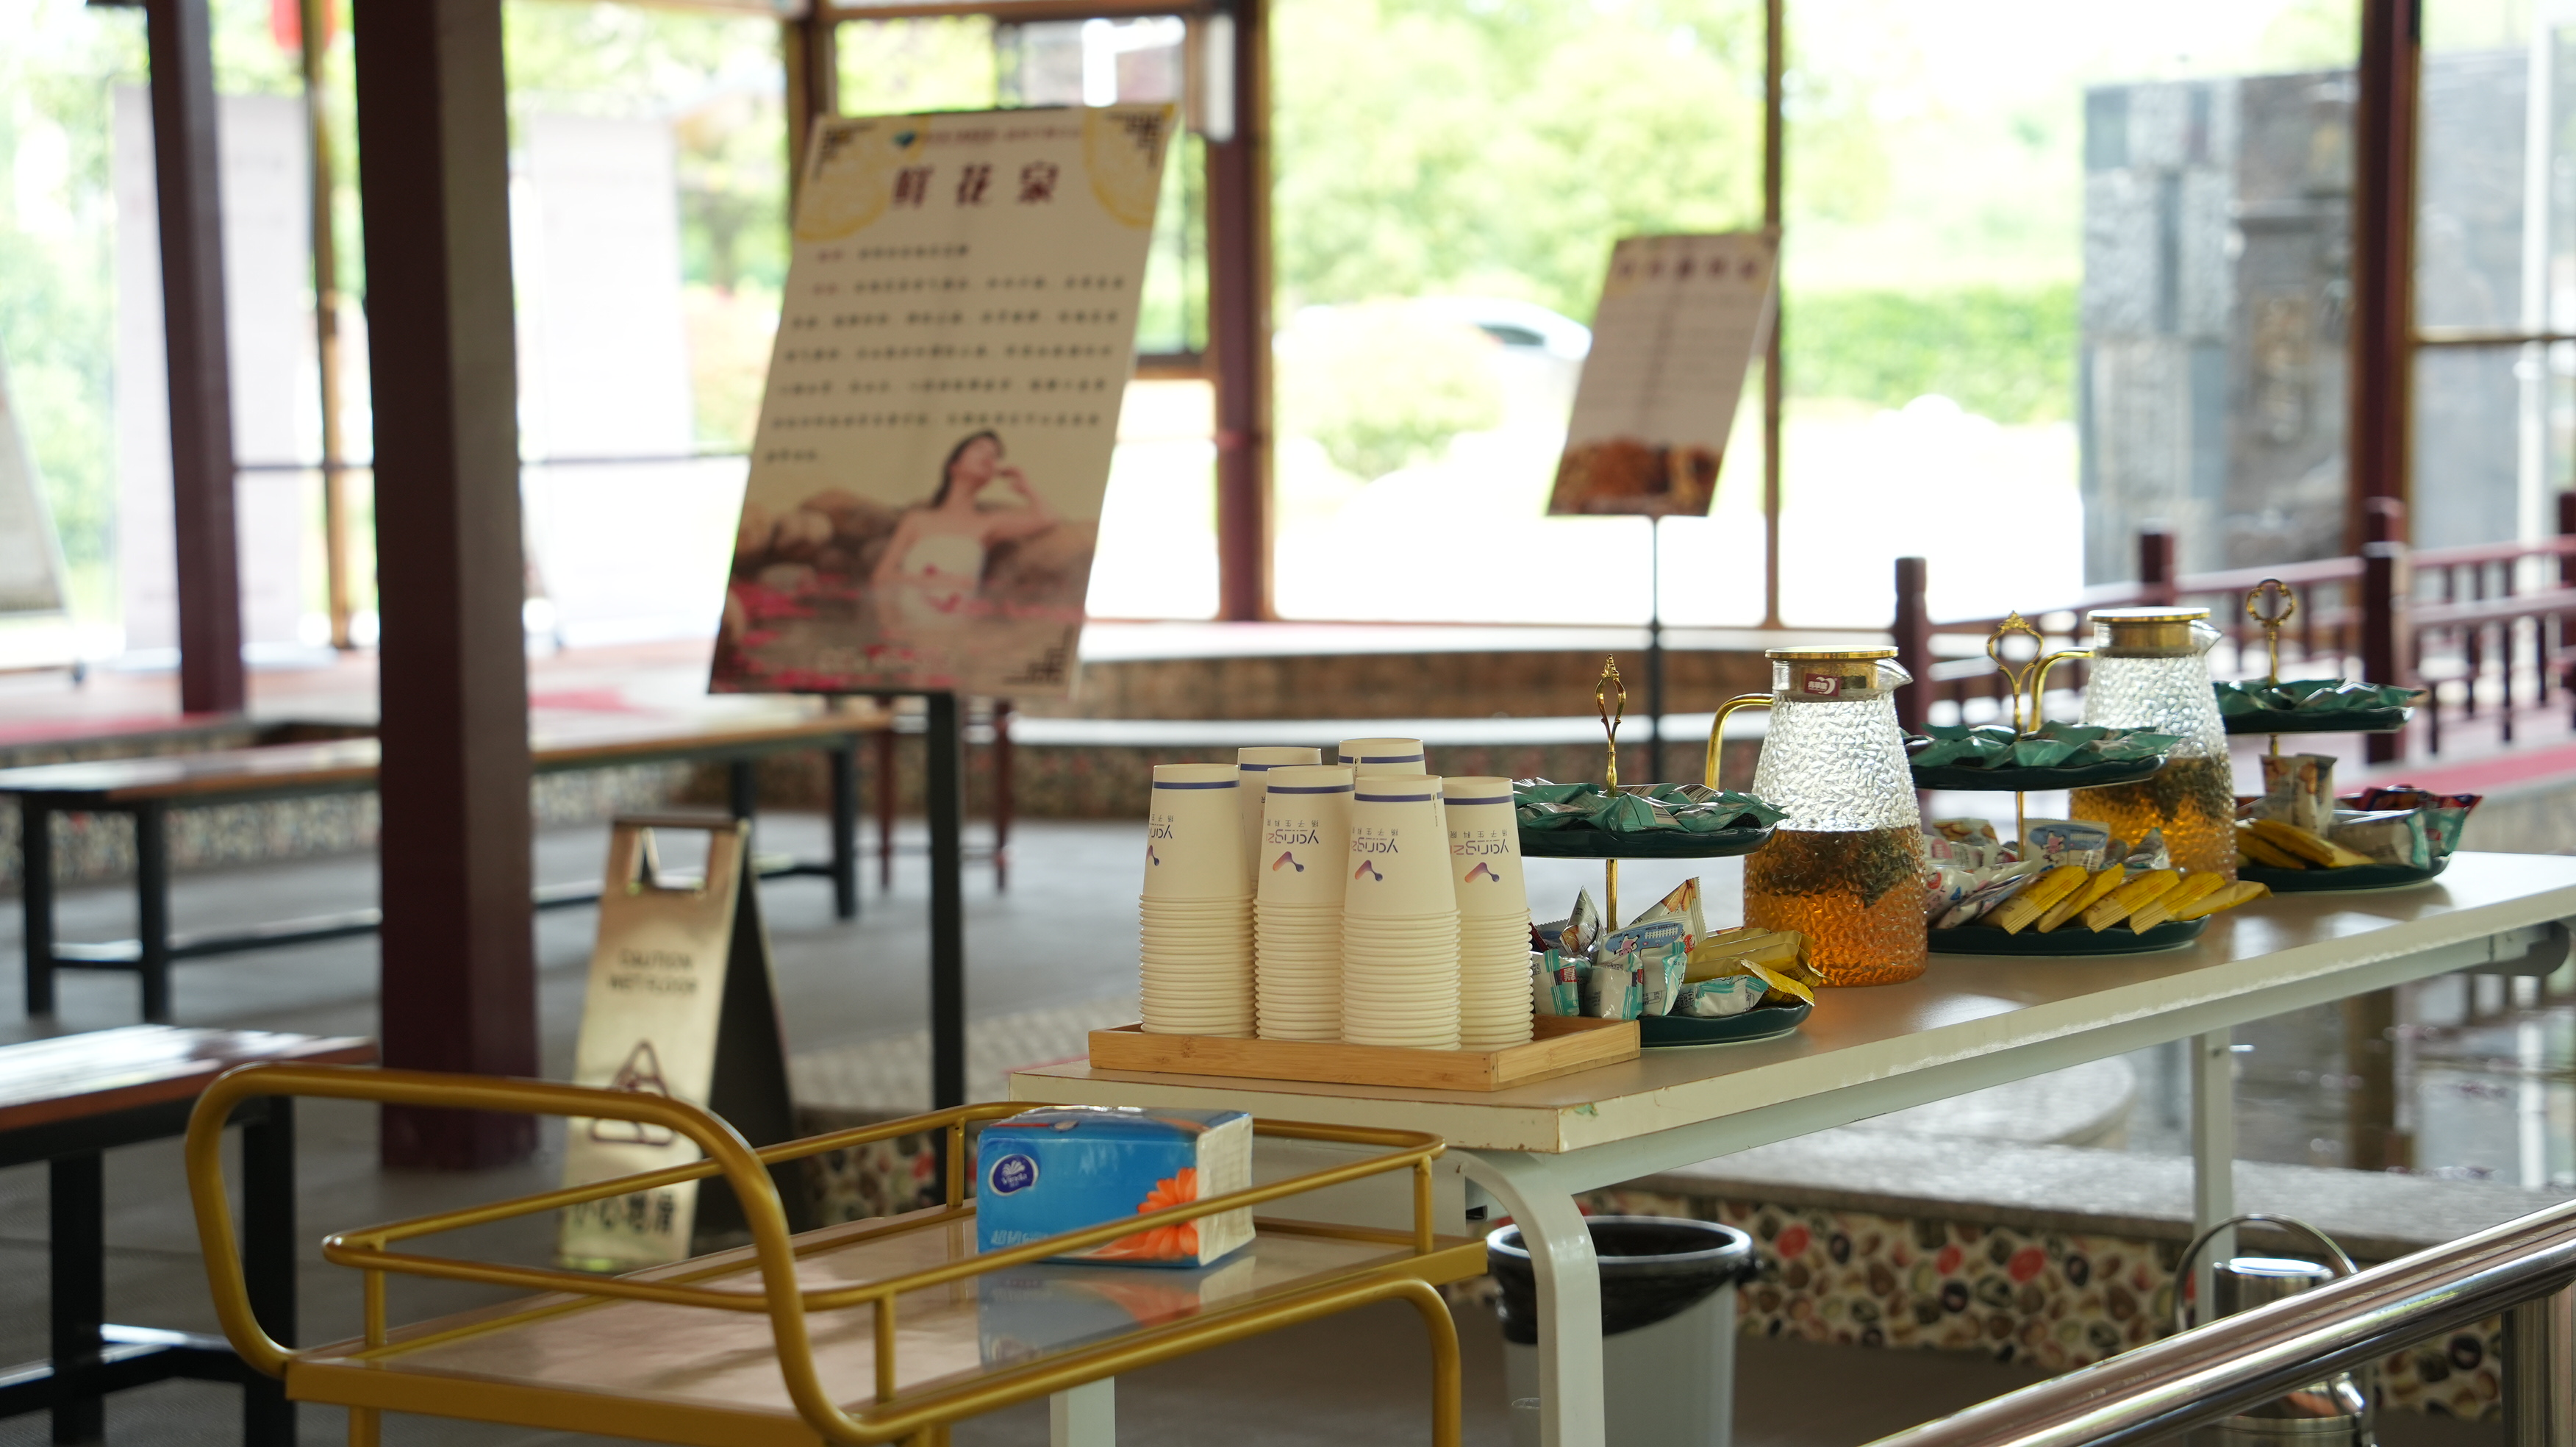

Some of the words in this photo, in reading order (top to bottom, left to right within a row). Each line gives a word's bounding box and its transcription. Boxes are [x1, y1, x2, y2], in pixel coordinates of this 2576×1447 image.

[1450, 829, 1508, 838] 扬子生科院
[1001, 1173, 1027, 1185] Vinda
